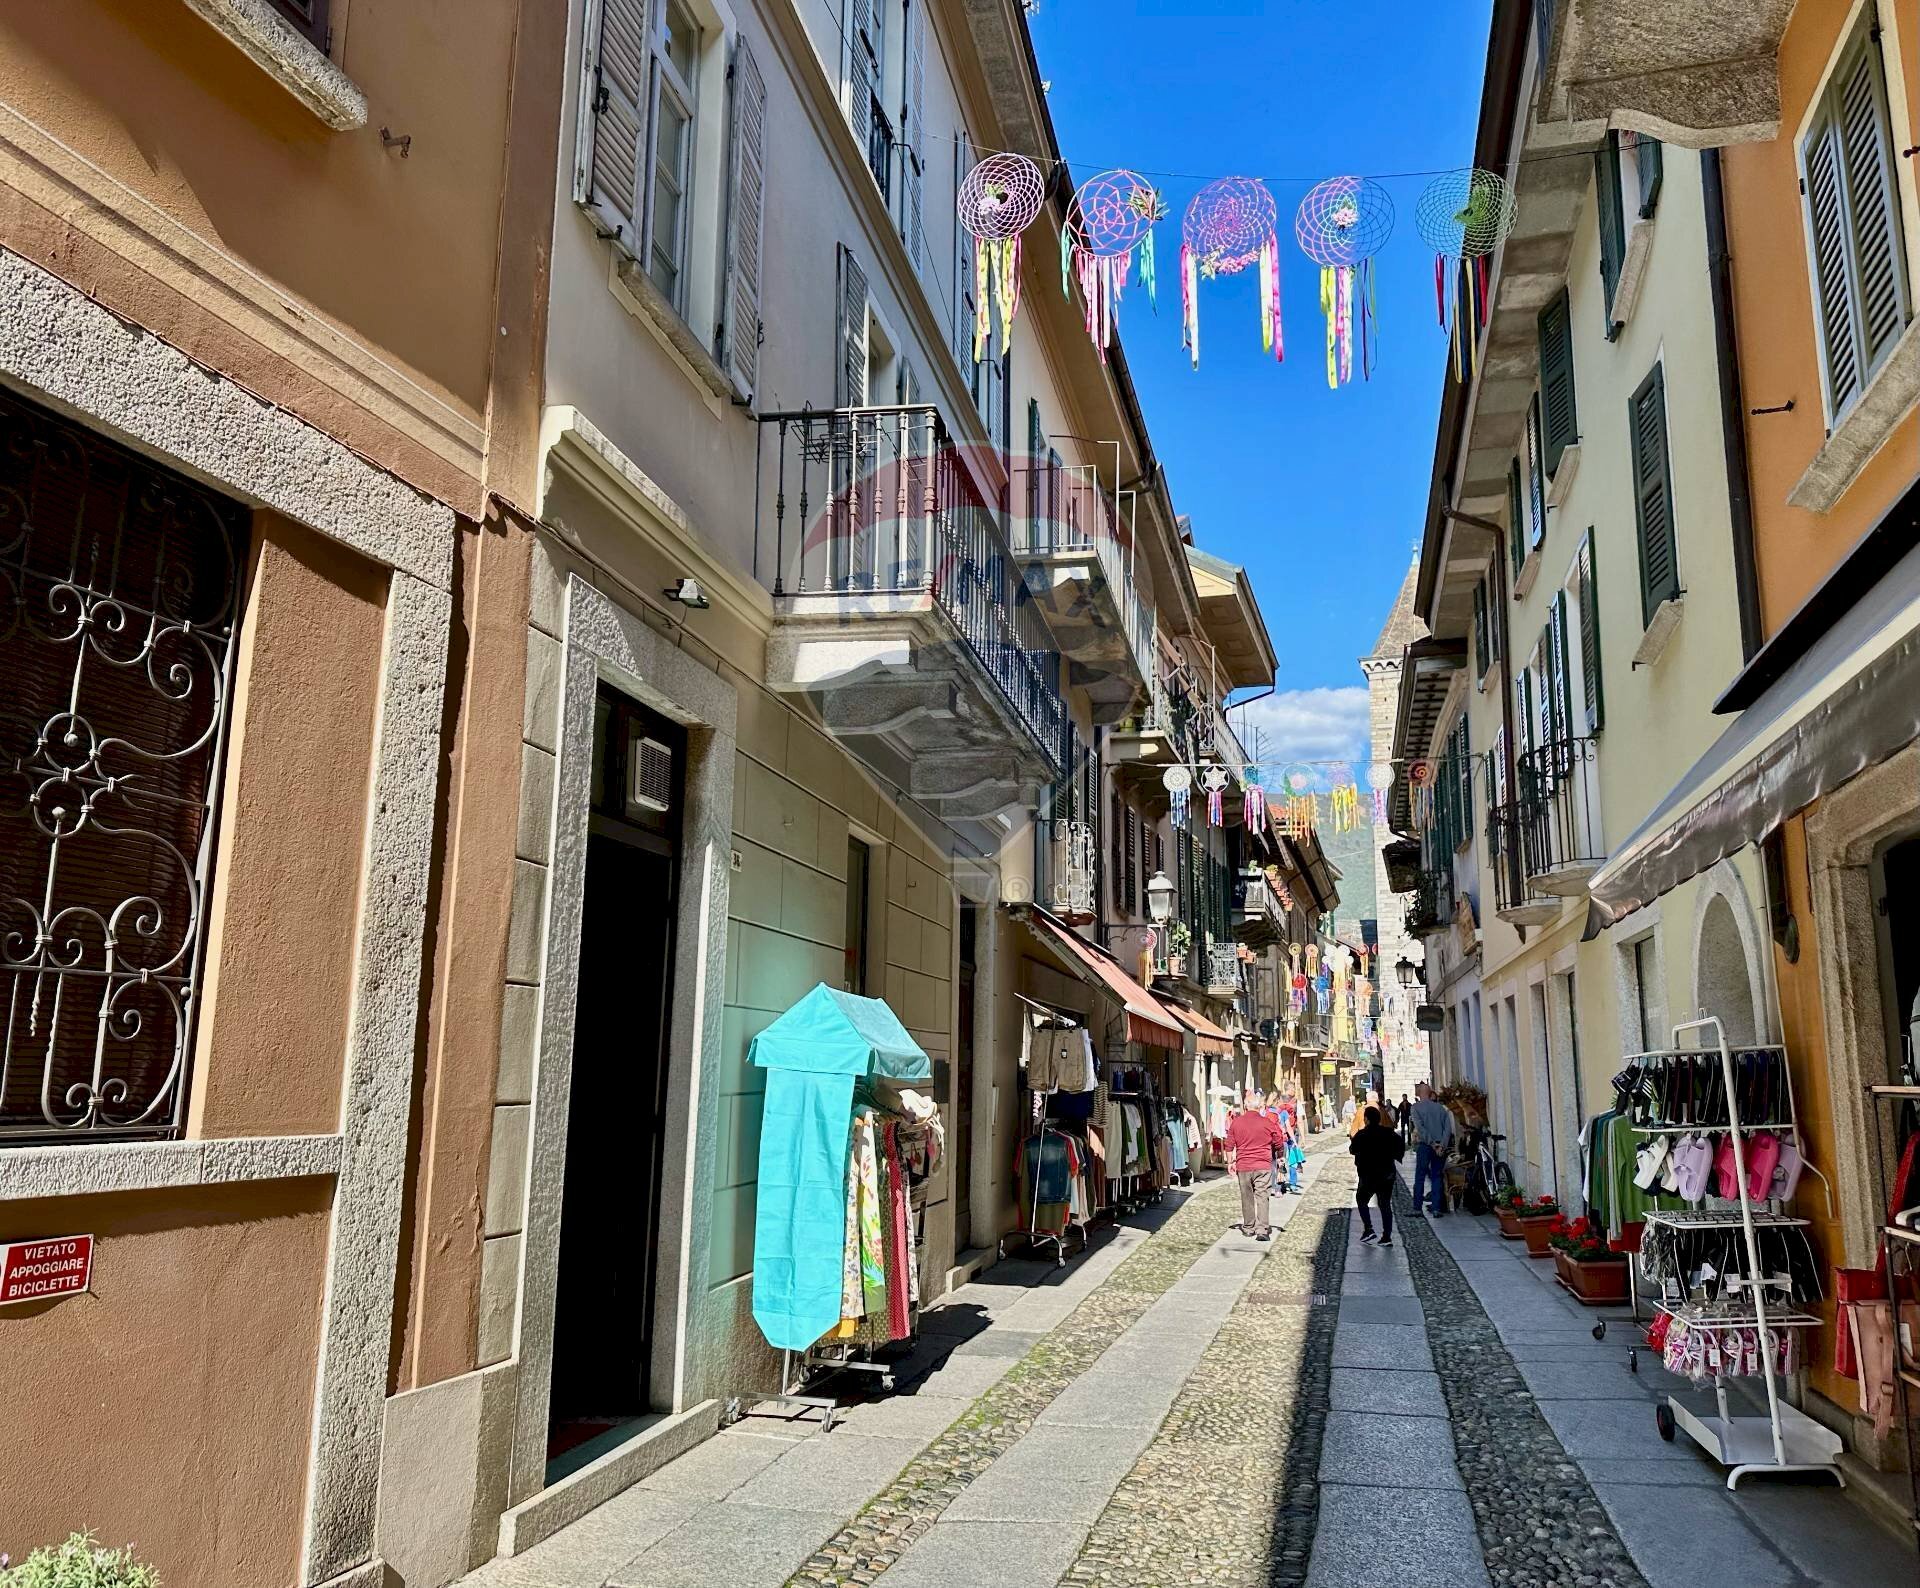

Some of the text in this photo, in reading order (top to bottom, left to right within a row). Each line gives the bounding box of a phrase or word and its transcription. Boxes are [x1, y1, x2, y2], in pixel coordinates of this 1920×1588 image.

[25, 1242, 76, 1260] VIETATO
[9, 1257, 84, 1279] APPOGGIARE
[9, 1275, 79, 1297] BICICLETTE
